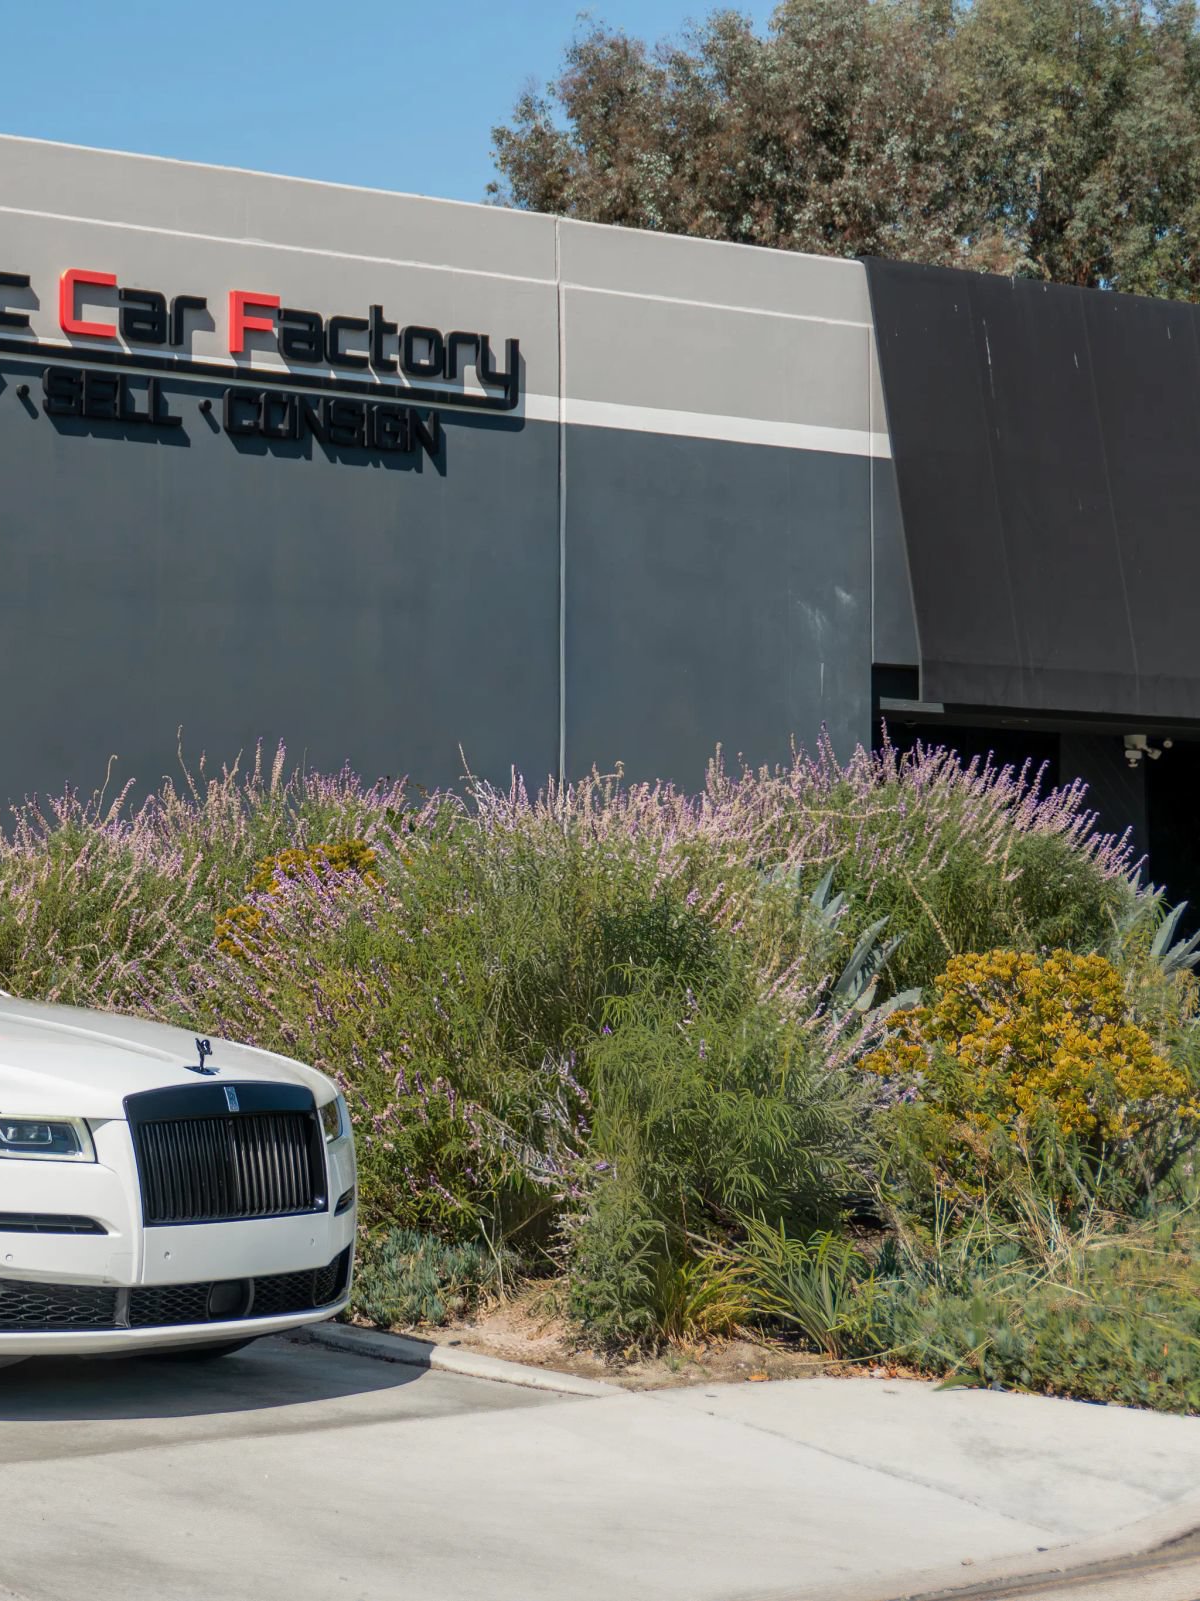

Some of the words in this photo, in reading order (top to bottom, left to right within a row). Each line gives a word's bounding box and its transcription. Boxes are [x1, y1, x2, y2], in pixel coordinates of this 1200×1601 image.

[59, 268, 208, 346] Car
[229, 289, 521, 411] Factory
[42, 366, 183, 426] SELL
[223, 387, 441, 456] CONSIGN
